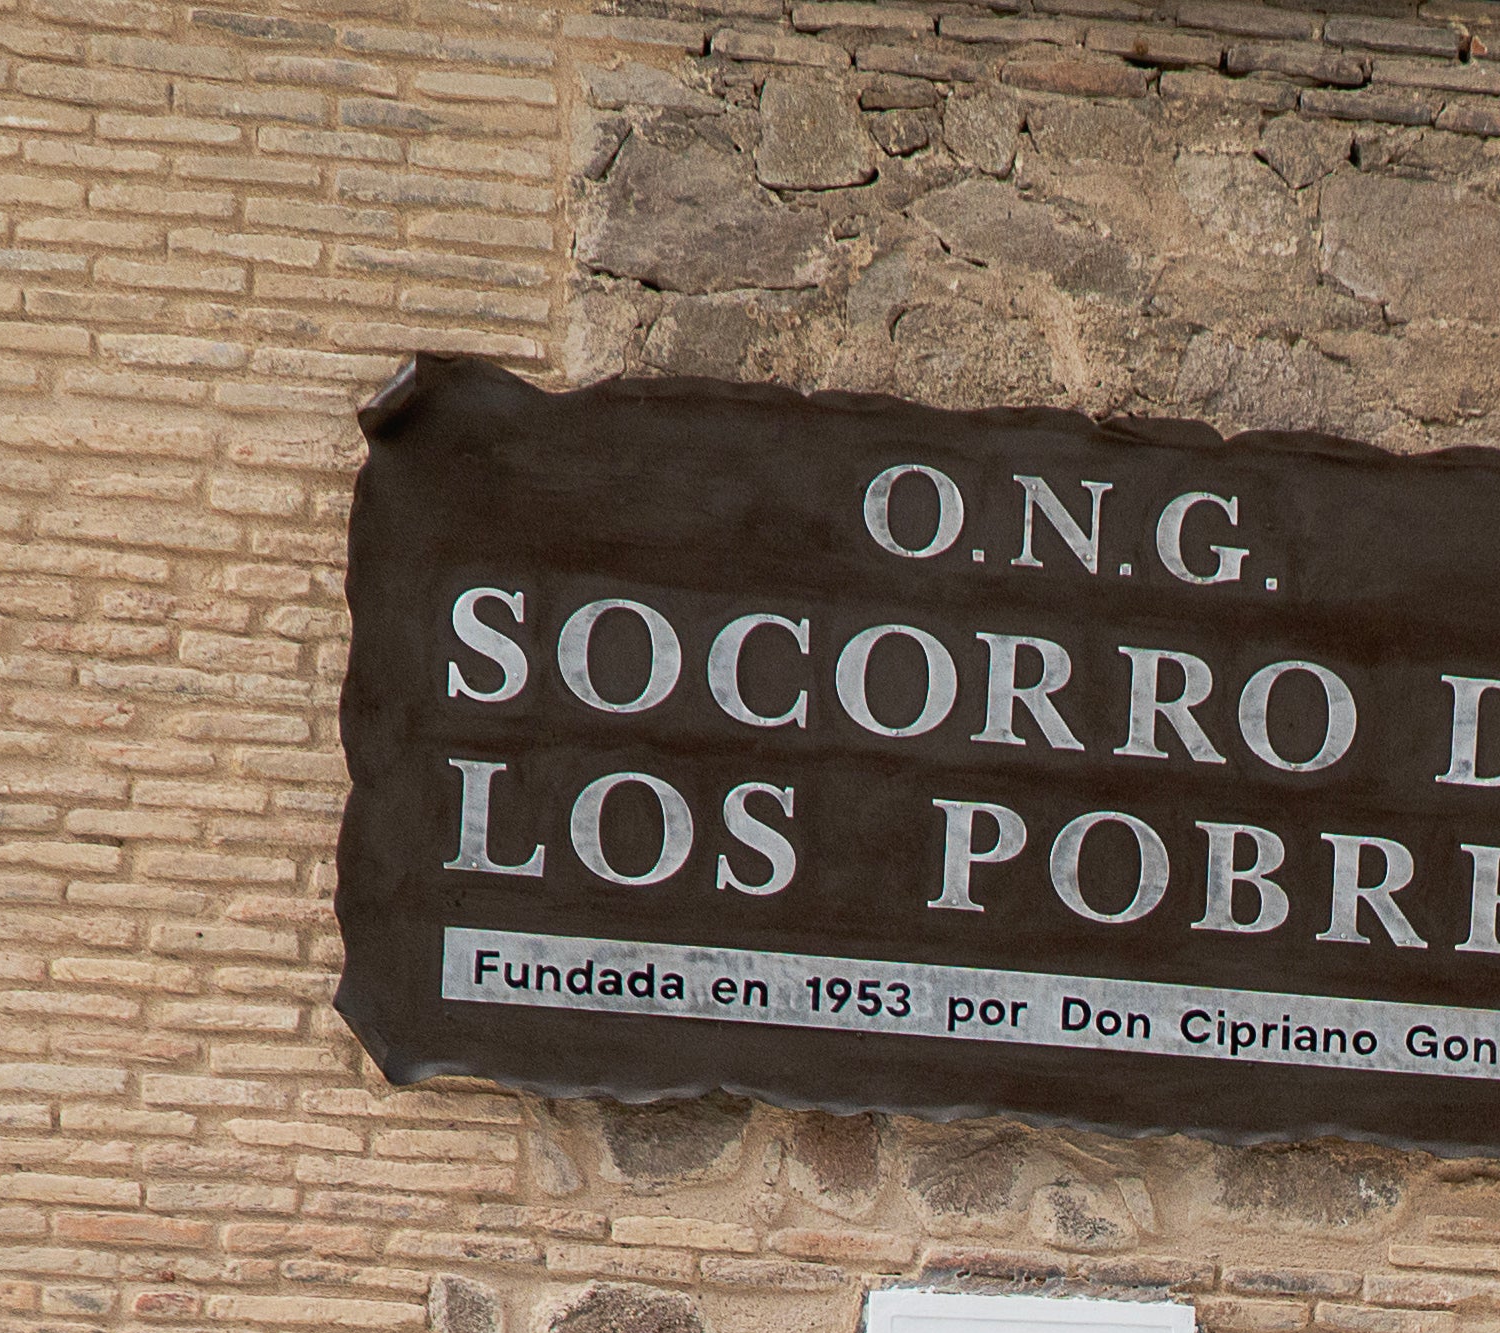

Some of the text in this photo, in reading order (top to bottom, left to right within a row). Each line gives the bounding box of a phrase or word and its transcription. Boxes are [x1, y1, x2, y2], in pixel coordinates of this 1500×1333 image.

[864, 465, 1277, 590] O.N.G.
[449, 586, 1357, 772] SOCORRO
[444, 759, 796, 895] LOS
[472, 951, 684, 1001] Fundada
[712, 979, 767, 1007] en
[807, 977, 910, 1017] 1953
[948, 998, 1027, 1031] por
[1062, 997, 1150, 1038] Don
[1180, 1010, 1377, 1057] Cipriano
